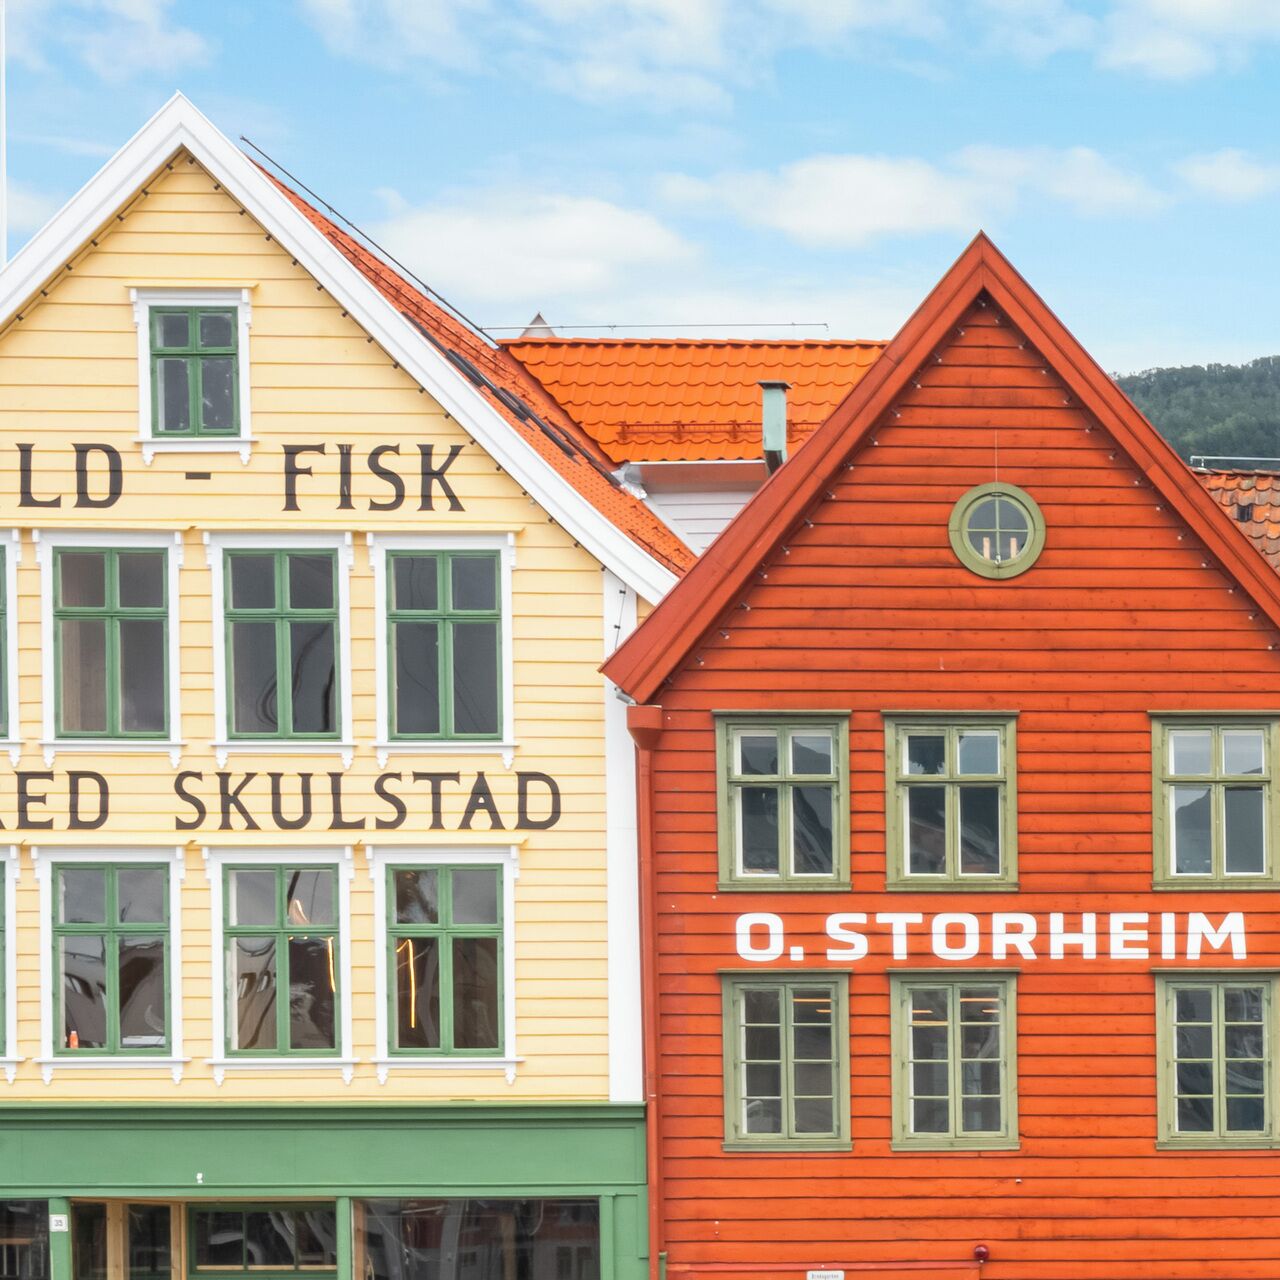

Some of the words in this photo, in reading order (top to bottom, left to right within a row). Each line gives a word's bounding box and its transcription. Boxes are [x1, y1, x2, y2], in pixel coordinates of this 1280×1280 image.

[282, 444, 466, 512] FISK
[0, 770, 109, 830] ED
[174, 770, 562, 830] SKULSTAD
[735, 912, 804, 962] O.
[825, 912, 1247, 962] STORHEIM
